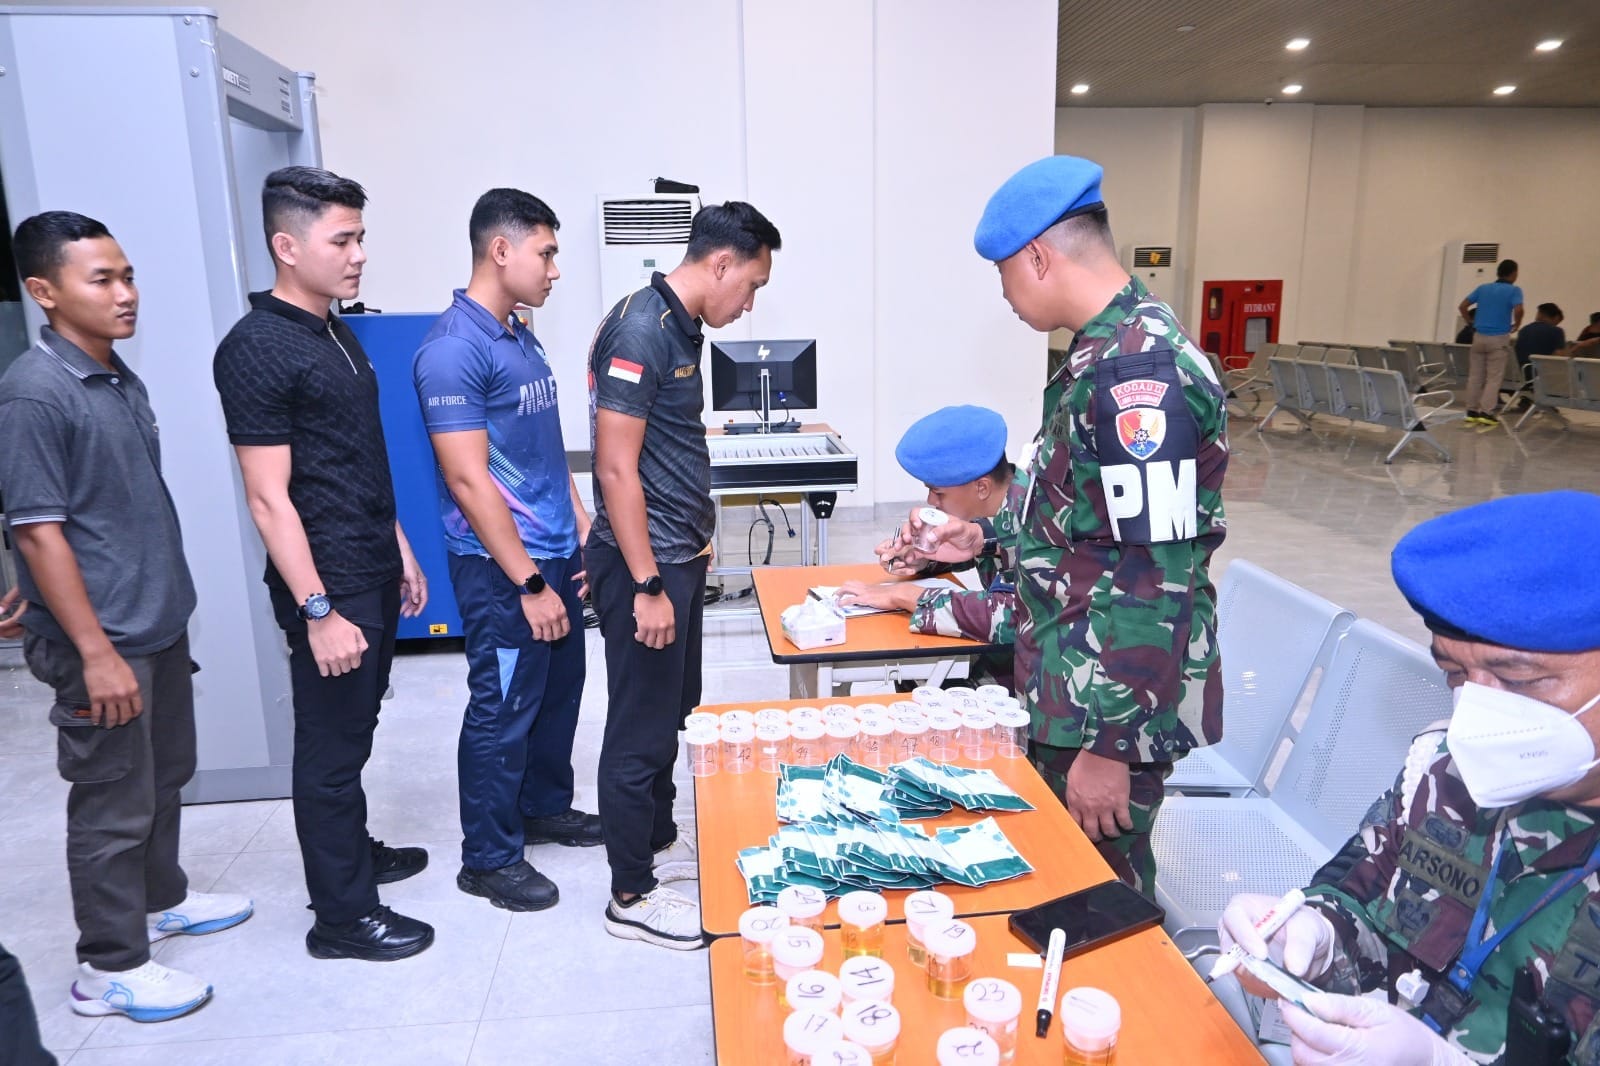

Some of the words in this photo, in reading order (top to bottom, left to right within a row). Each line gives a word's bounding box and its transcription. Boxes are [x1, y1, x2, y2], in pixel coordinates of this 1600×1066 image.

[1243, 303, 1276, 313] HYDRANT
[1116, 383, 1153, 396] KODAU
[428, 397, 440, 407] AIR
[441, 395, 467, 406] FORCE
[1100, 459, 1197, 542] PM
[1400, 840, 1480, 898] ARSONO
[849, 966, 885, 986] 14
[797, 982, 825, 998] 16
[971, 983, 1005, 1002] 23
[804, 1014, 829, 1032] 17
[857, 1004, 892, 1026] 18
